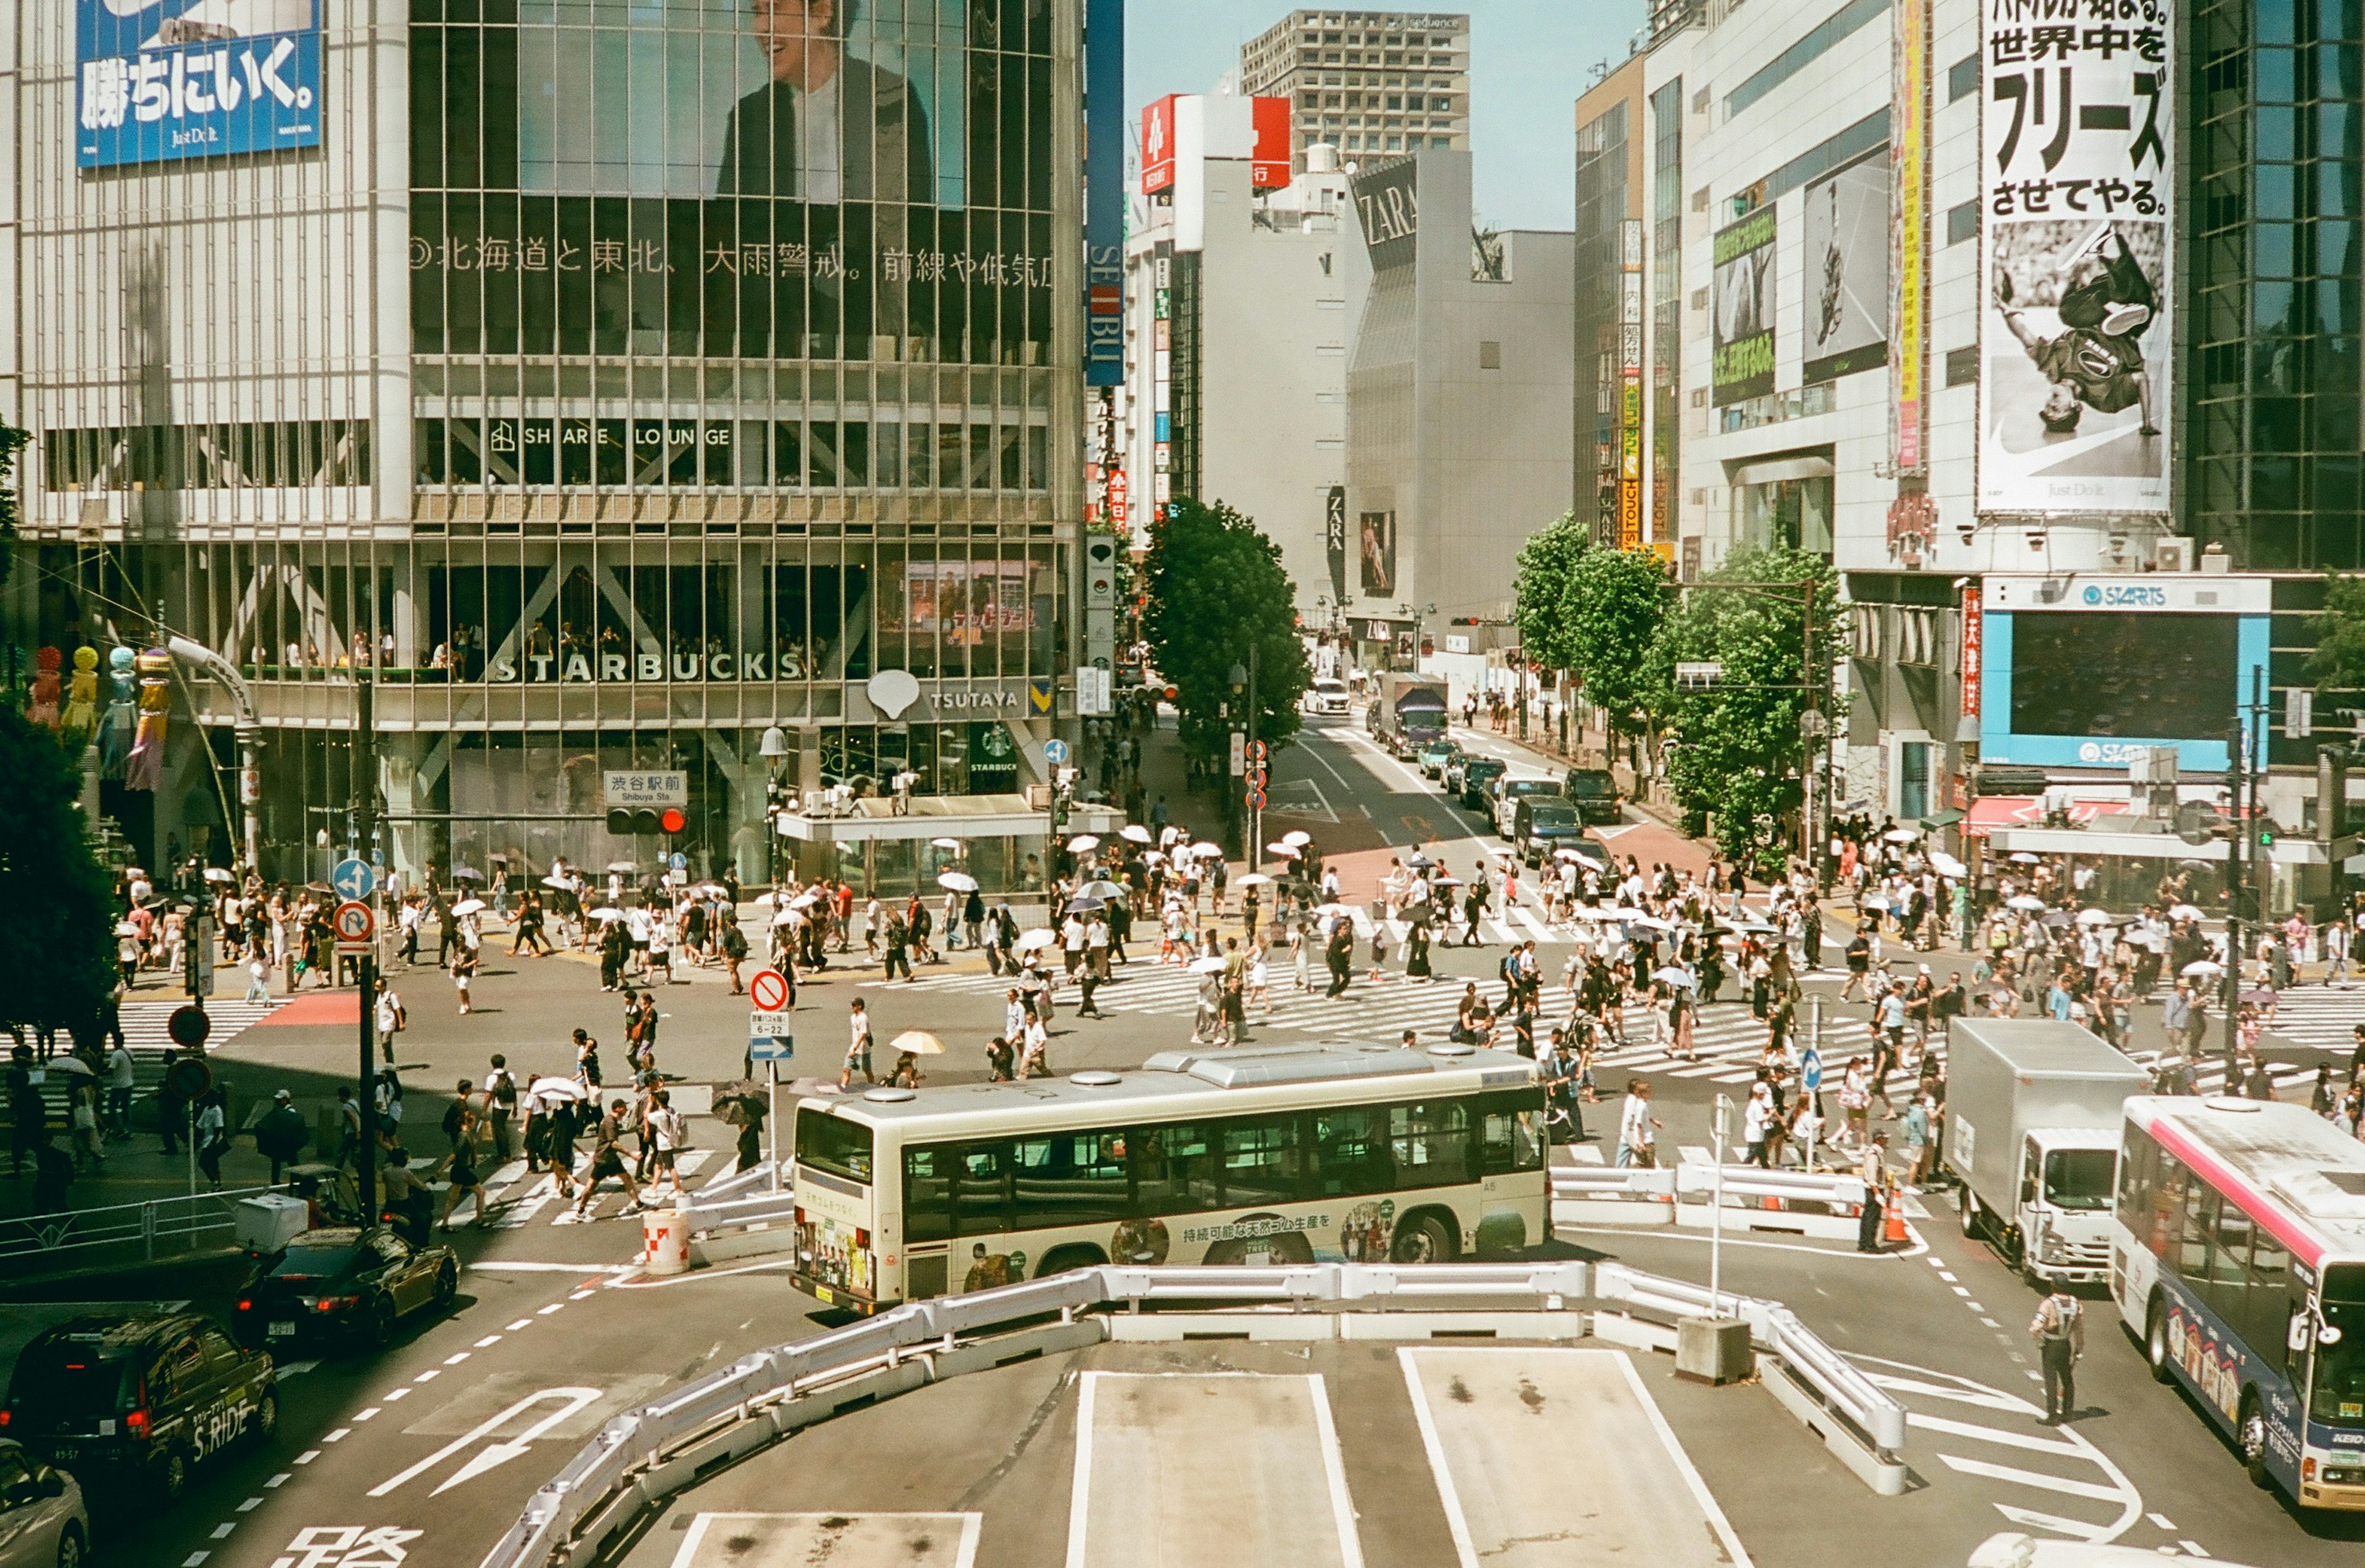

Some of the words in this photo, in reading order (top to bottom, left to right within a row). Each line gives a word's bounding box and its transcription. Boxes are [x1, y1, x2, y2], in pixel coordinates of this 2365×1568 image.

[1990, 24, 2167, 65] 世界中を
[81, 37, 313, 129] 勝ちにいく。
[1993, 66, 2167, 177] フリーズ
[172, 128, 191, 148] Just
[1992, 178, 2167, 216] させてやる。
[1354, 184, 1417, 245] ZARA
[437, 236, 675, 273] 北海道と東北、
[705, 240, 859, 280] 大雨警戒。
[1090, 246, 1120, 363] SEIBU
[525, 428, 608, 445] SHARE
[636, 429, 730, 445] LOUNGE
[1626, 481, 1637, 528] TOUCH
[1330, 496, 1343, 551] ZARA
[2105, 586, 2166, 606] STARTS
[495, 653, 801, 682] STARBUCKS
[931, 692, 1017, 708] TSUTAYA
[612, 775, 680, 791] 渋谷駅前
[622, 793, 653, 802] Shibuya
[757, 1025, 782, 1034] 6-22
[1183, 1214, 1330, 1243] 持続可能な天然ゴム生産を
[1247, 1245, 1268, 1253] TREE
[193, 1397, 248, 1462] S.RIDE
[2333, 1433, 2363, 1444] KEIO
